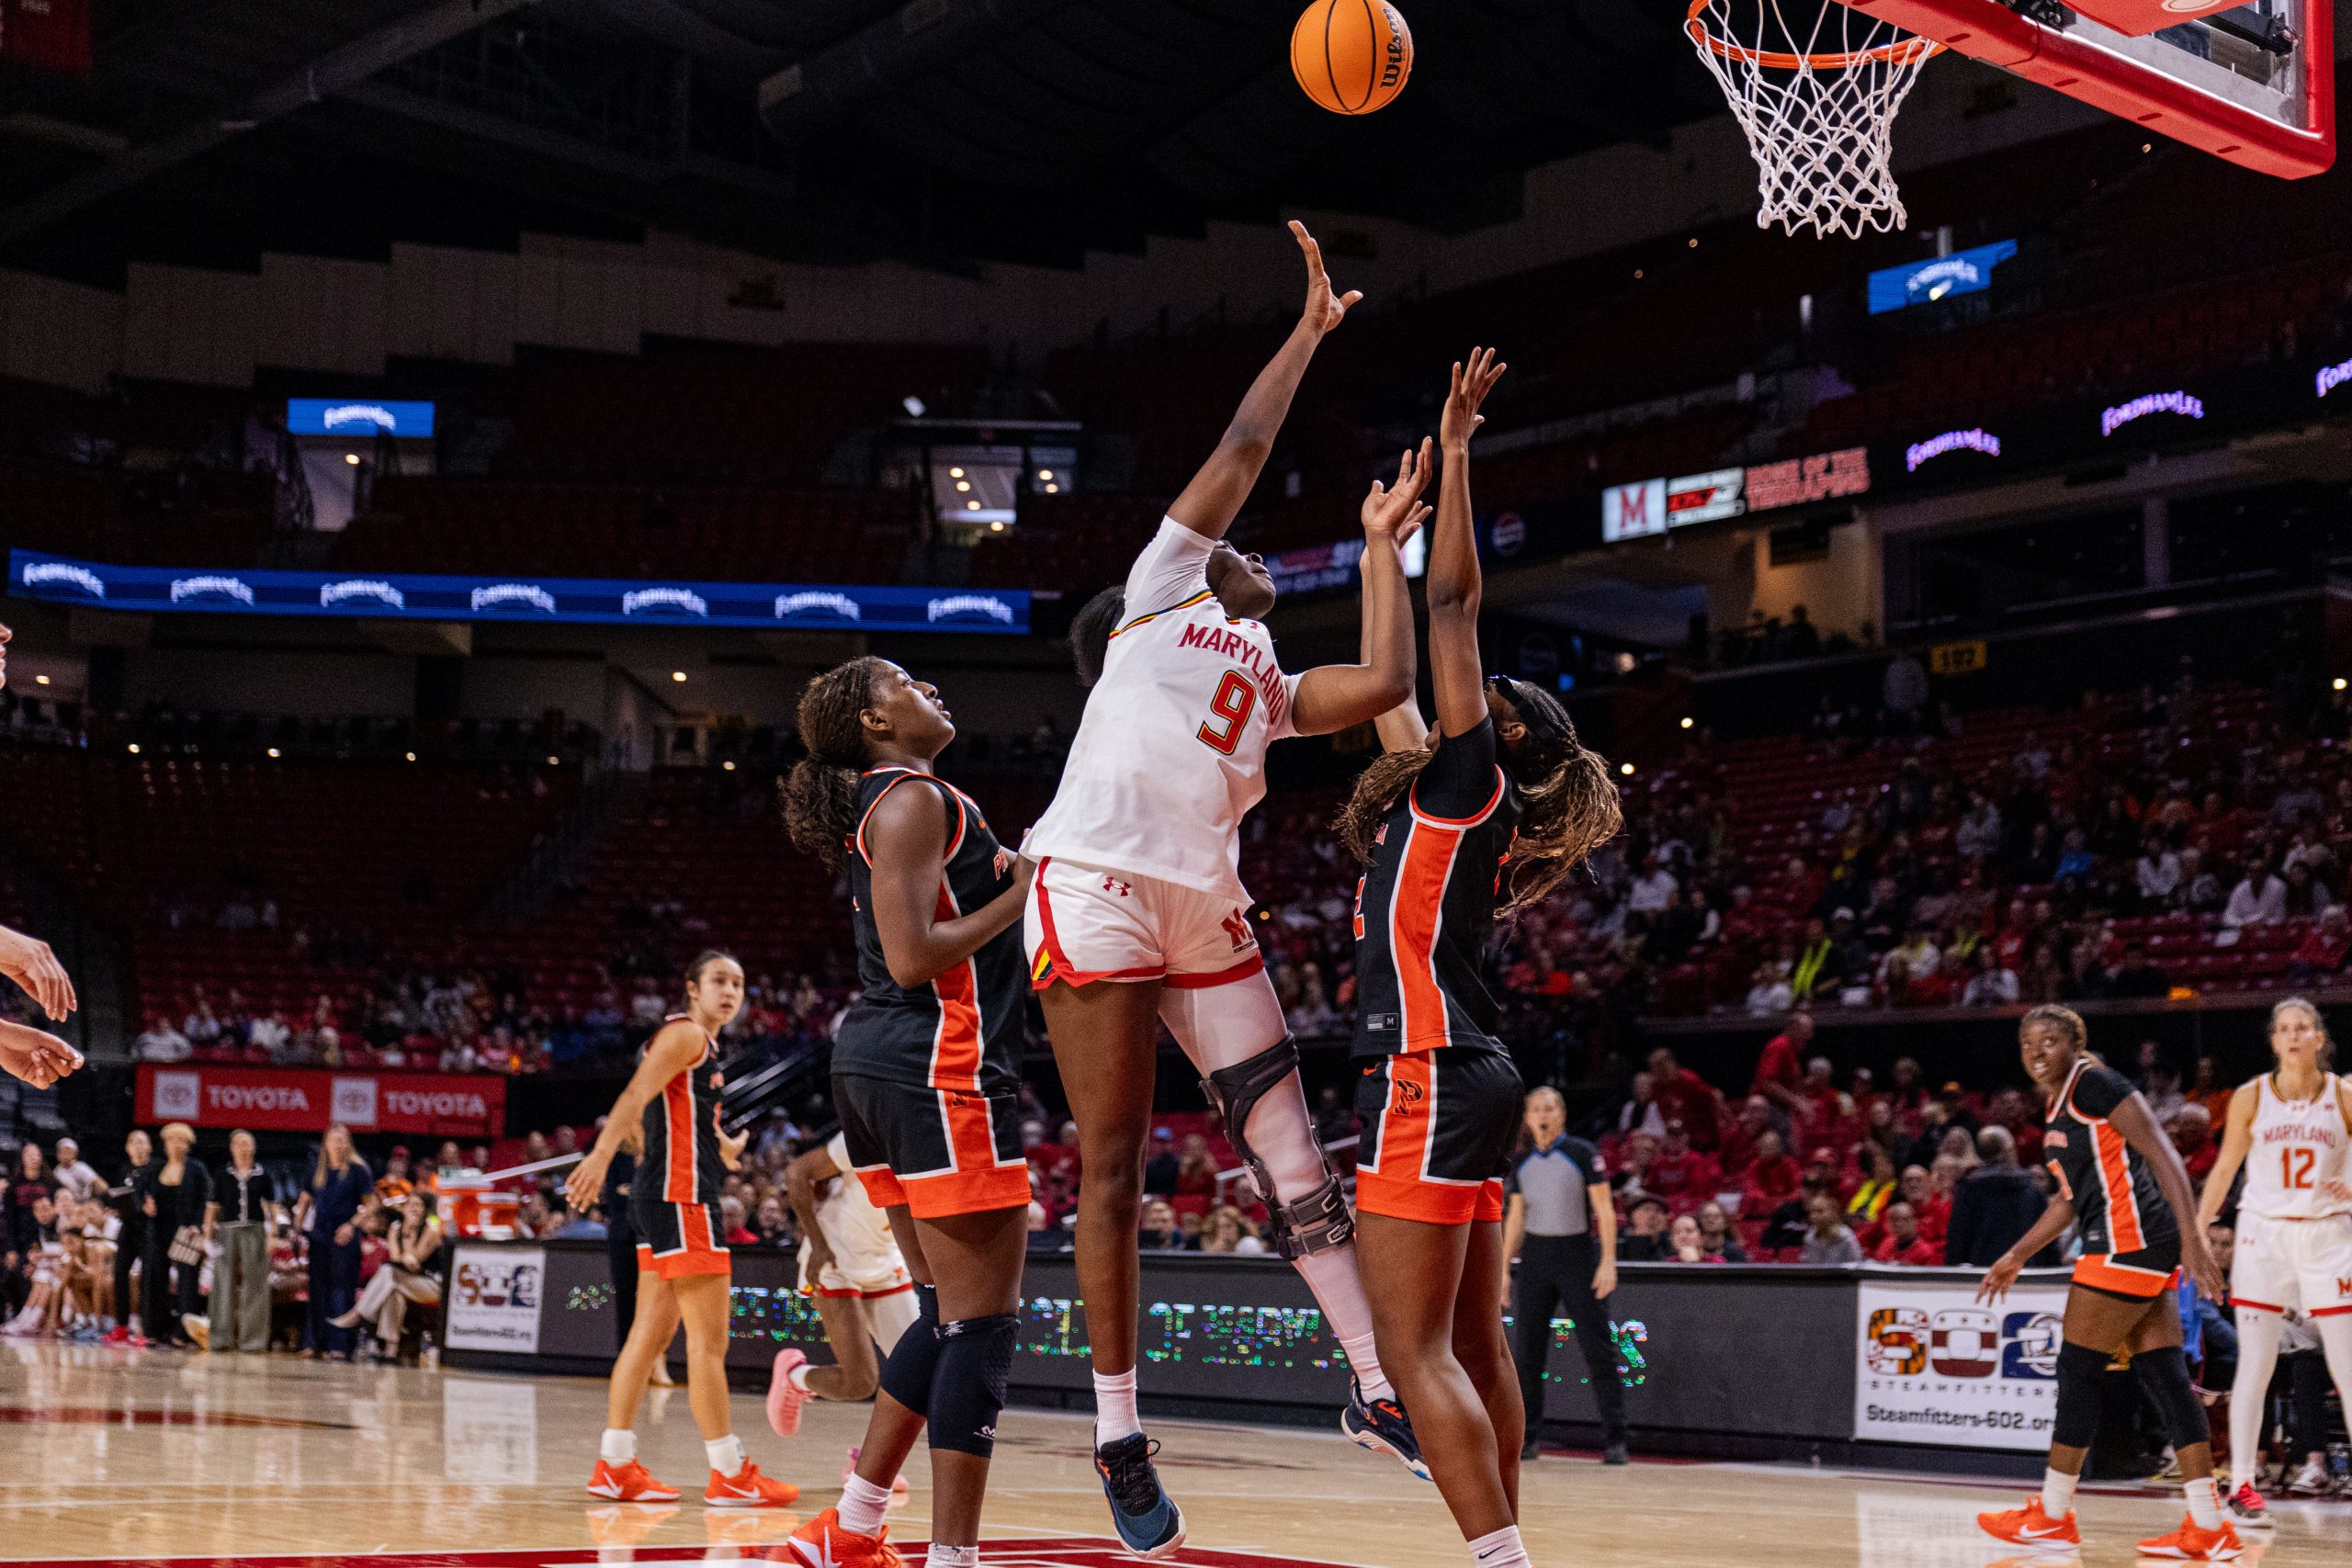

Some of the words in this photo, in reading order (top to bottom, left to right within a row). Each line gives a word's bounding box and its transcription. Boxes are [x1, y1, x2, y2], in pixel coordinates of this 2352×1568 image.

[1619, 485, 1646, 528] M
[1177, 623, 1283, 726] MARYLAND
[1196, 670, 1257, 756] 9
[207, 1085, 310, 1111] TOYOTA
[384, 1090, 487, 1117] TOYOTA
[1393, 1079, 1424, 1115] P
[2264, 1123, 2336, 1149] MARYLAND
[2281, 1146, 2315, 1189] 12
[1868, 1307, 2063, 1380] 602
[1867, 1404, 2057, 1431] Steamfitters-602.or
